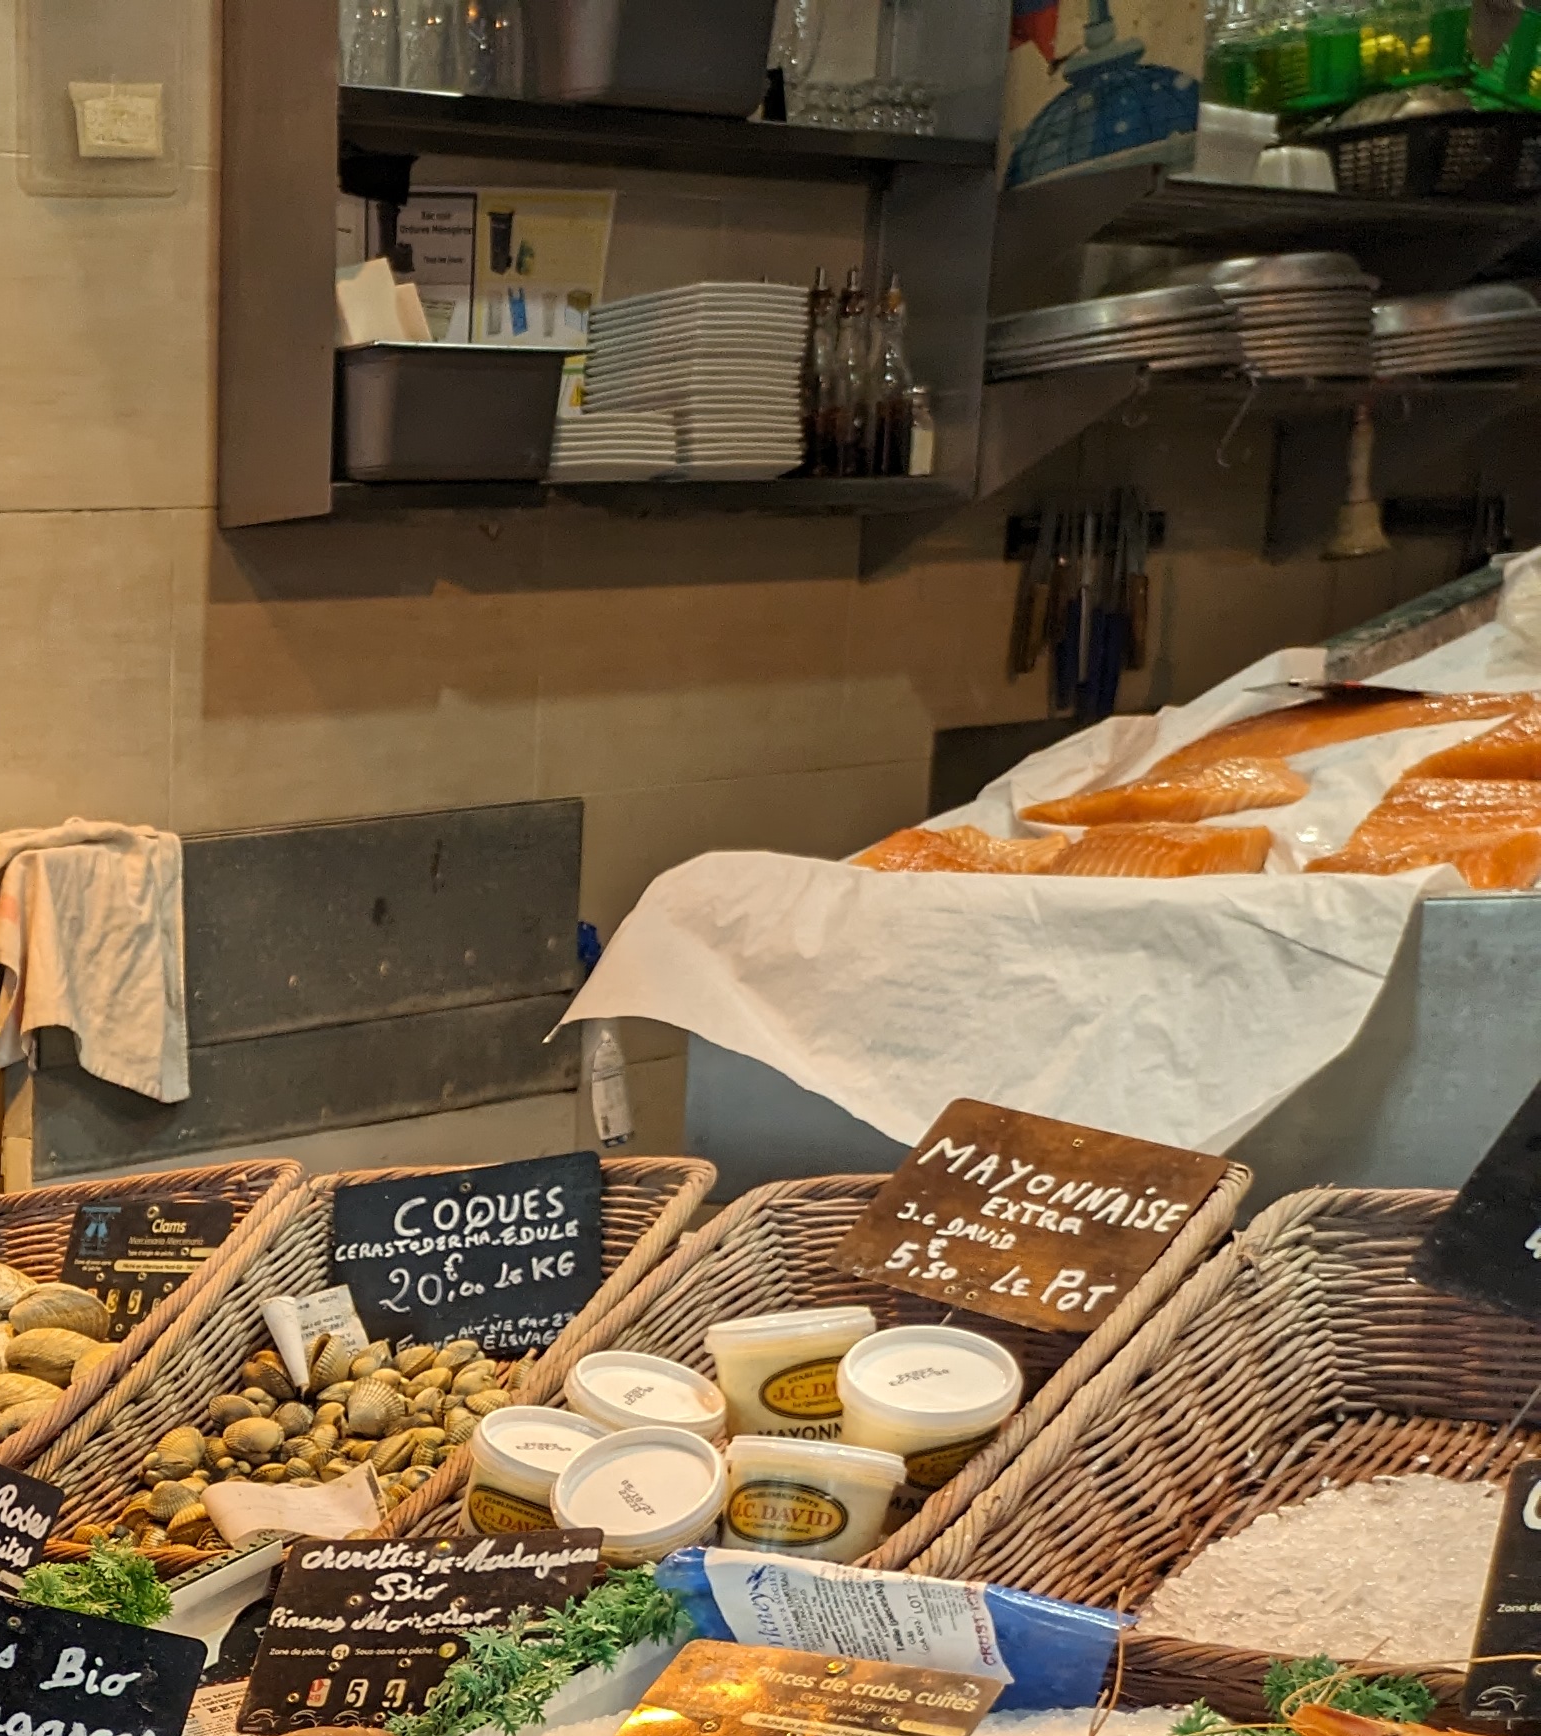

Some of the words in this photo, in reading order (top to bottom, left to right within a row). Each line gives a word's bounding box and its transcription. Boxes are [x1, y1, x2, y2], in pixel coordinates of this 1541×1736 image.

[151, 1218, 187, 1234] Clams
[393, 1185, 565, 1238] COQUES
[979, 1196, 1085, 1236] EXTRA
[762, 1500, 835, 1530] DAVID
[1497, 1602, 1526, 1614] Zone
[39, 1646, 143, 1697] Bio
[755, 1666, 819, 1689] Pinces
[820, 1674, 847, 1693] de
[850, 1679, 912, 1703] crabe
[914, 1689, 979, 1714] cuites
[848, 1697, 902, 1717] Pagurus
